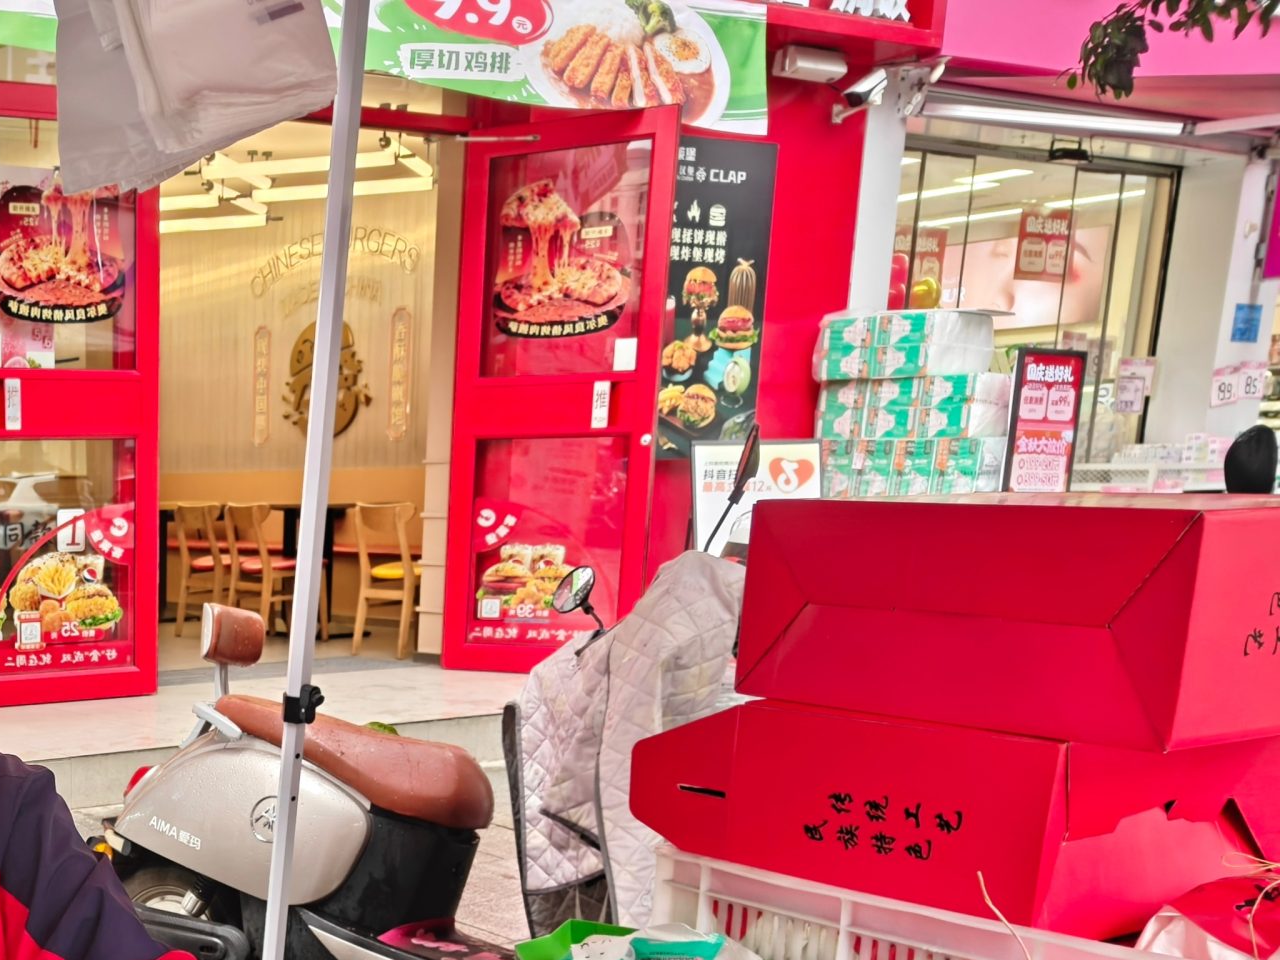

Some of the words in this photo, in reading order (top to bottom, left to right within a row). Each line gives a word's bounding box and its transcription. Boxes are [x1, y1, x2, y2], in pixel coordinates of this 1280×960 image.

[409, 48, 511, 74] 厚切鸡排
[709, 168, 747, 184] CLAP
[250, 232, 324, 298] CHINESE
[1026, 363, 1074, 382] 国庆送好礼
[827, 792, 964, 835] 传统工艺
[803, 819, 933, 862] 民族特色
